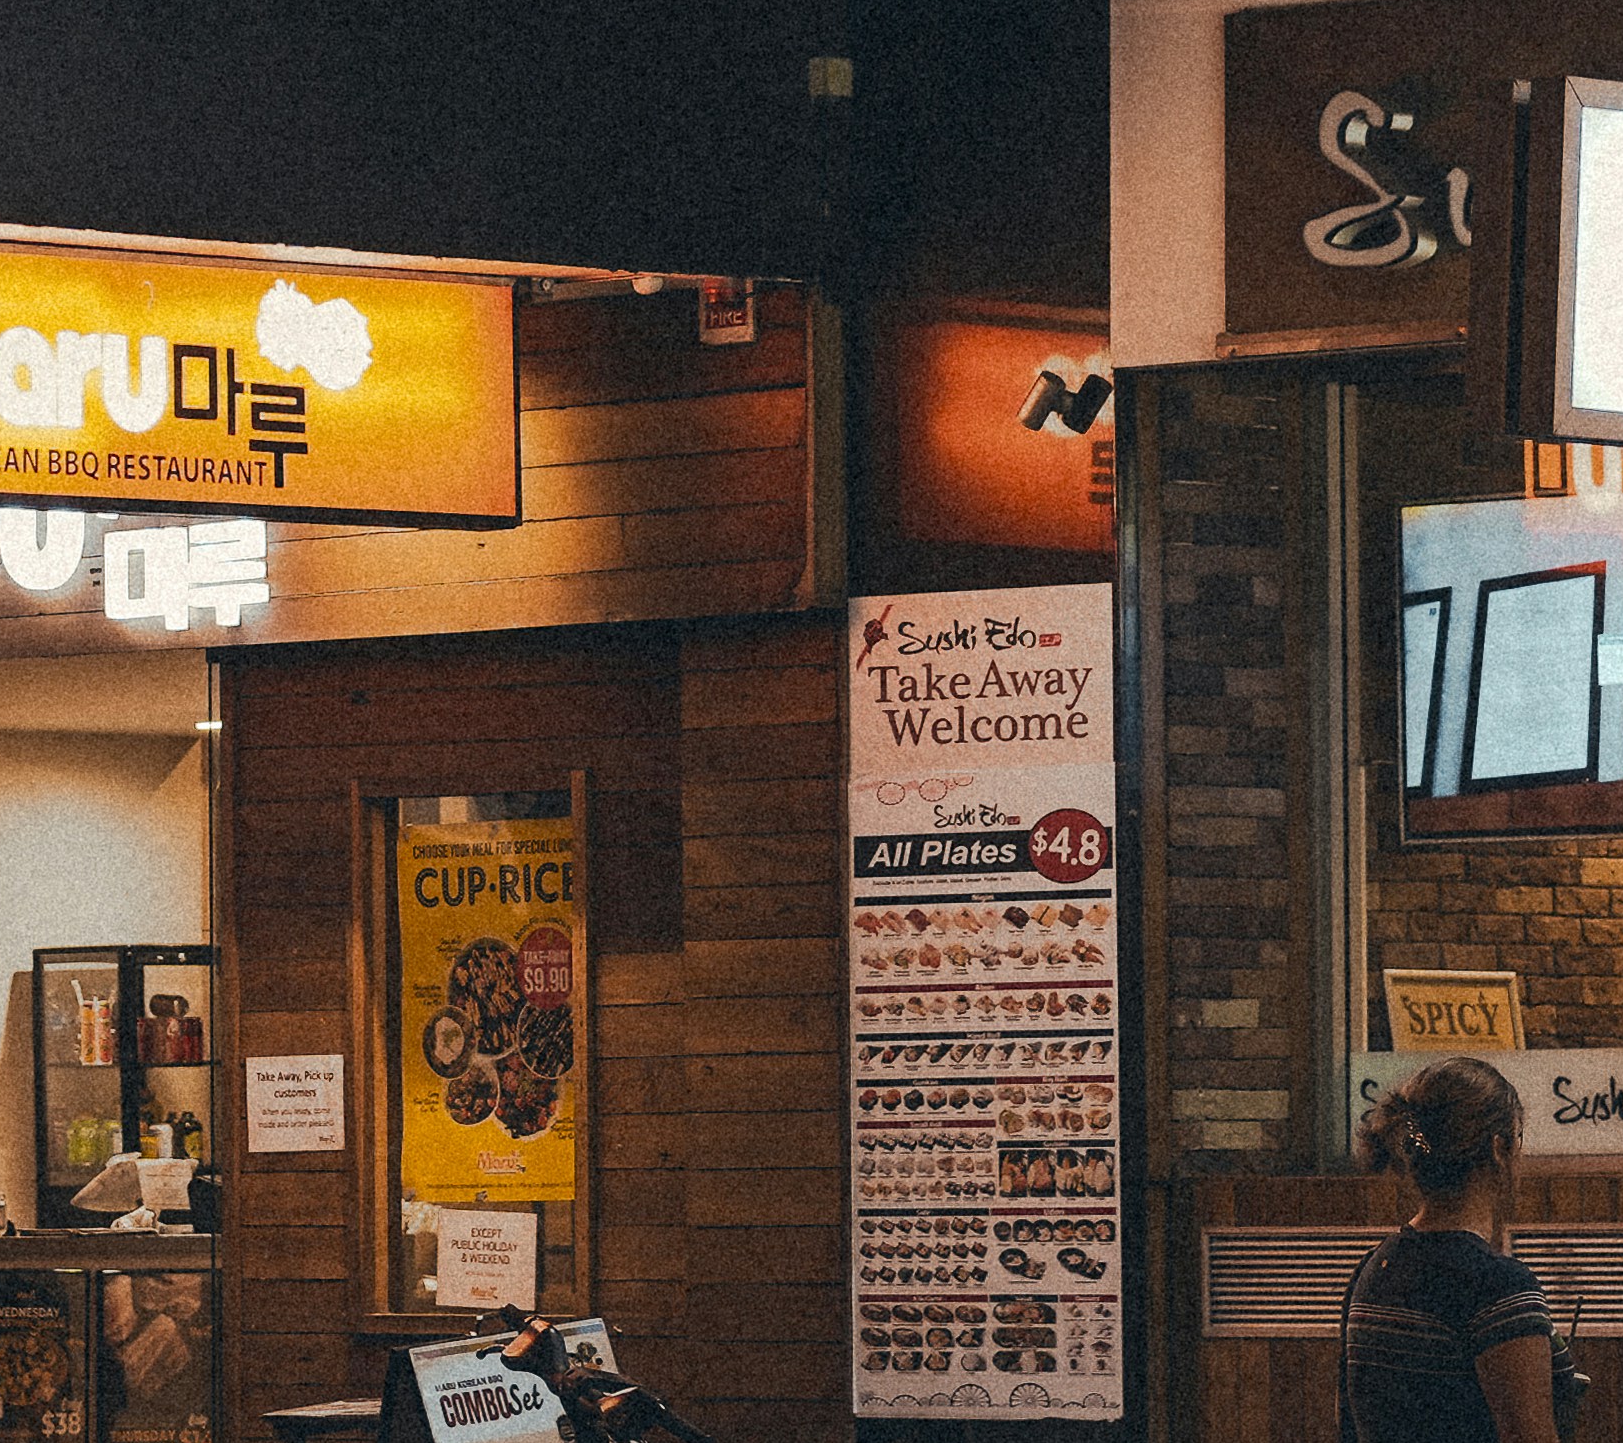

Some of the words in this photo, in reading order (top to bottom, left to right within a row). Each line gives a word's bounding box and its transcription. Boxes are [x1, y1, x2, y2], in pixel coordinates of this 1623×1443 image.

[172, 341, 310, 490] 마루
[47, 447, 102, 481] BBQ
[106, 452, 270, 489] RESTAURANT
[102, 517, 272, 631] 마루
[898, 618, 977, 656] Sushi
[983, 617, 1038, 650] Edo
[867, 662, 972, 704] Take
[975, 659, 1094, 711] Away
[882, 706, 1090, 747] Welcome
[933, 804, 976, 829] Sushi
[978, 803, 1008, 828] Edo
[412, 843, 449, 860] CHOOSE
[472, 842, 494, 857] MEAL
[867, 840, 909, 868] All
[919, 839, 1018, 867] Plates
[1031, 826, 1102, 867] $4.8
[523, 966, 570, 994] $9.90
[1405, 1001, 1499, 1037] SPICY
[256, 1071, 276, 1082] Take
[304, 1070, 321, 1081] Pick
[323, 1071, 335, 1083] up
[274, 1088, 317, 1099] customers
[451, 1239, 481, 1251] PUBLIC
[482, 1241, 518, 1252] HOLIDAY
[470, 1227, 503, 1239] EXCEPT
[470, 1253, 510, 1265] WEEKEND
[457, 1377, 487, 1391] KOREAN
[487, 1374, 504, 1386] BBQ
[439, 1385, 512, 1429] COMBO
[508, 1383, 545, 1416] Set
[41, 1411, 83, 1437] $38
